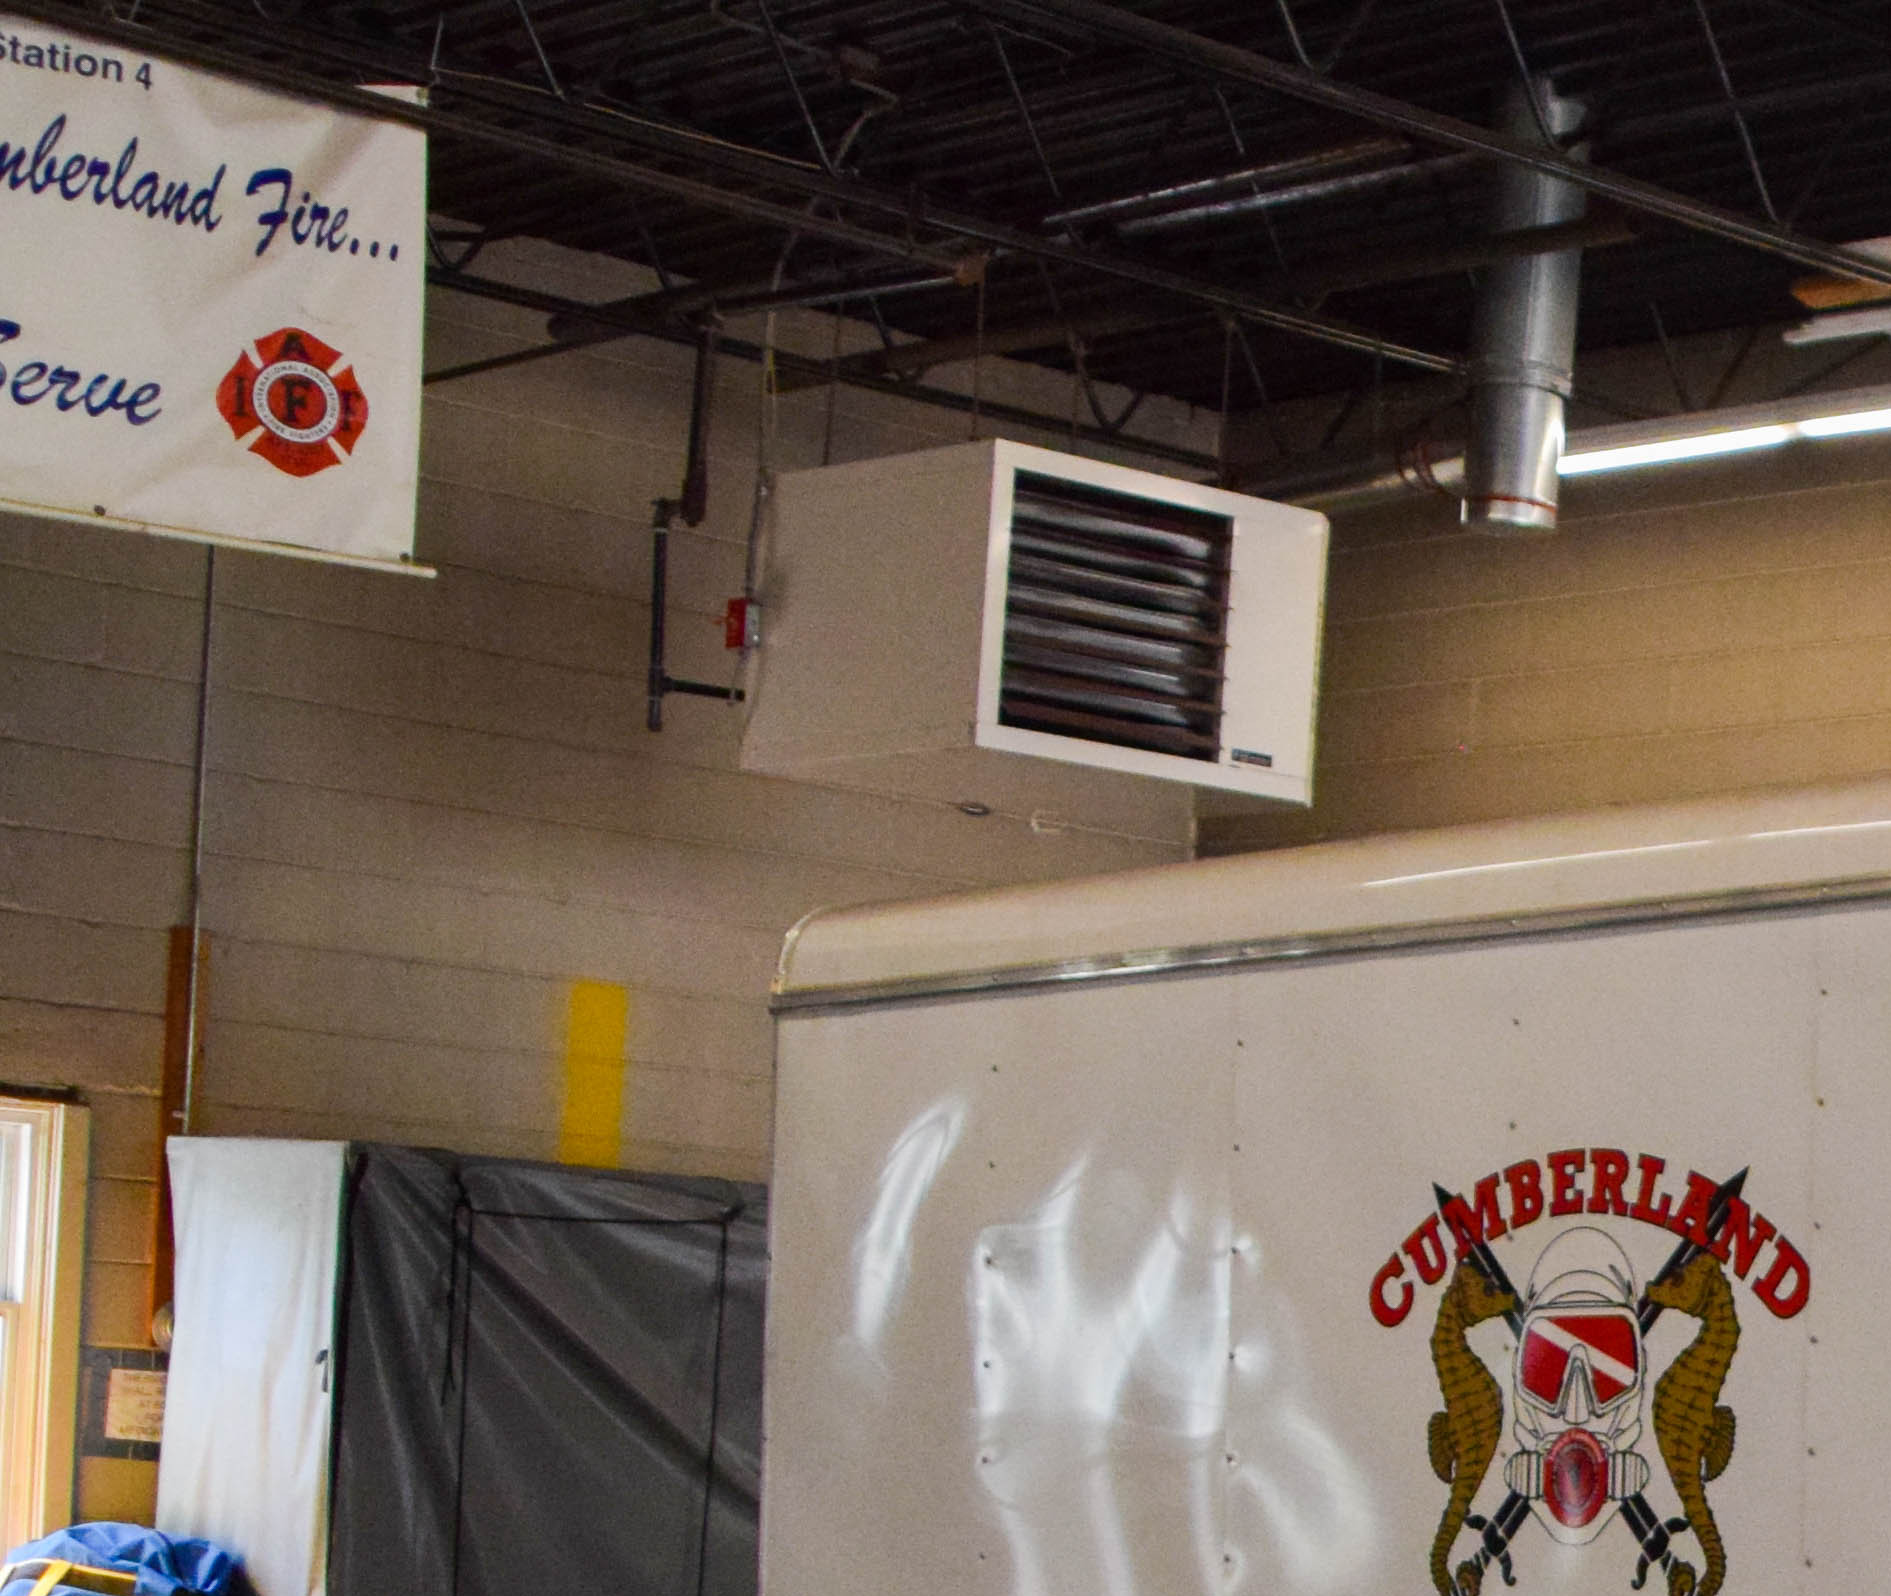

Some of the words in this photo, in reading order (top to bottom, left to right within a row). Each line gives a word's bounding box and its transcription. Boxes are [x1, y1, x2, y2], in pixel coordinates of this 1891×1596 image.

[134, 62, 154, 91] 4
[246, 167, 399, 262] Fire...
[1368, 1147, 1812, 1328] CUMBERLAND
